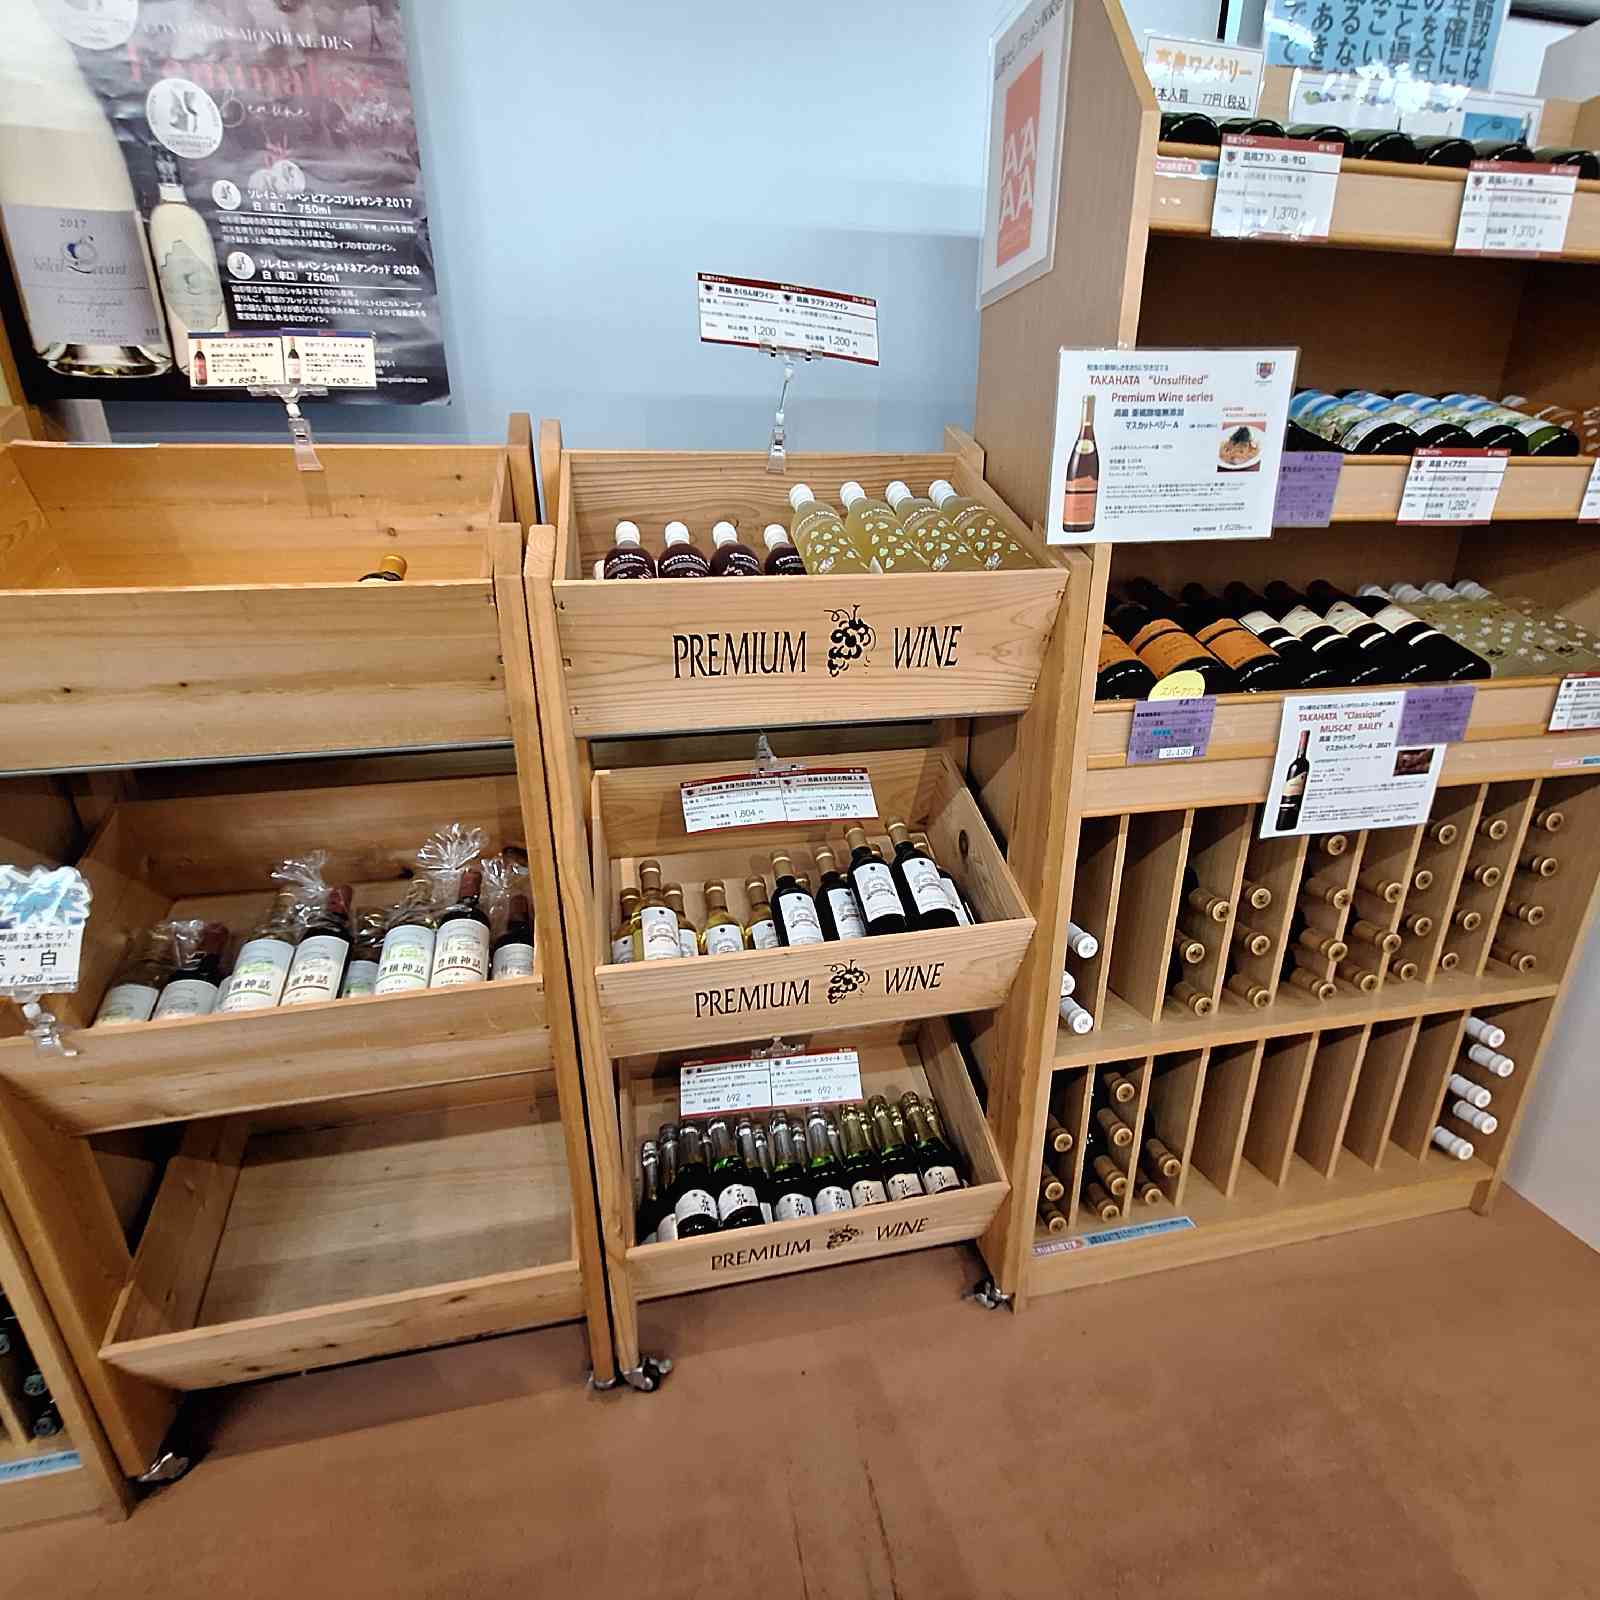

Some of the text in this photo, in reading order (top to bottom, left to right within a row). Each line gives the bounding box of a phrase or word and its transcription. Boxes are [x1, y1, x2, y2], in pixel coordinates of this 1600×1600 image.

[320, 37, 353, 51] DES
[298, 203, 332, 216] 750ml
[385, 198, 413, 209] 2017
[59, 216, 87, 230] 2017
[393, 264, 420, 276] 2020
[306, 271, 340, 283] 750ml
[752, 325, 777, 338] 1,200
[828, 335, 851, 348] 1,200
[1089, 375, 1140, 385] TAKAHATA
[1111, 392, 1214, 403] Premium Wine series
[672, 625, 963, 679] PREMIUM WINE
[1297, 712, 1338, 721] TAKAHATA
[1319, 724, 1353, 733] MUSCAT
[1357, 722, 1384, 731] BAILEY
[733, 808, 756, 819] 1,804
[695, 962, 945, 1018] PREMIUM WINE
[711, 1217, 929, 1271] PREMIUM WINE
